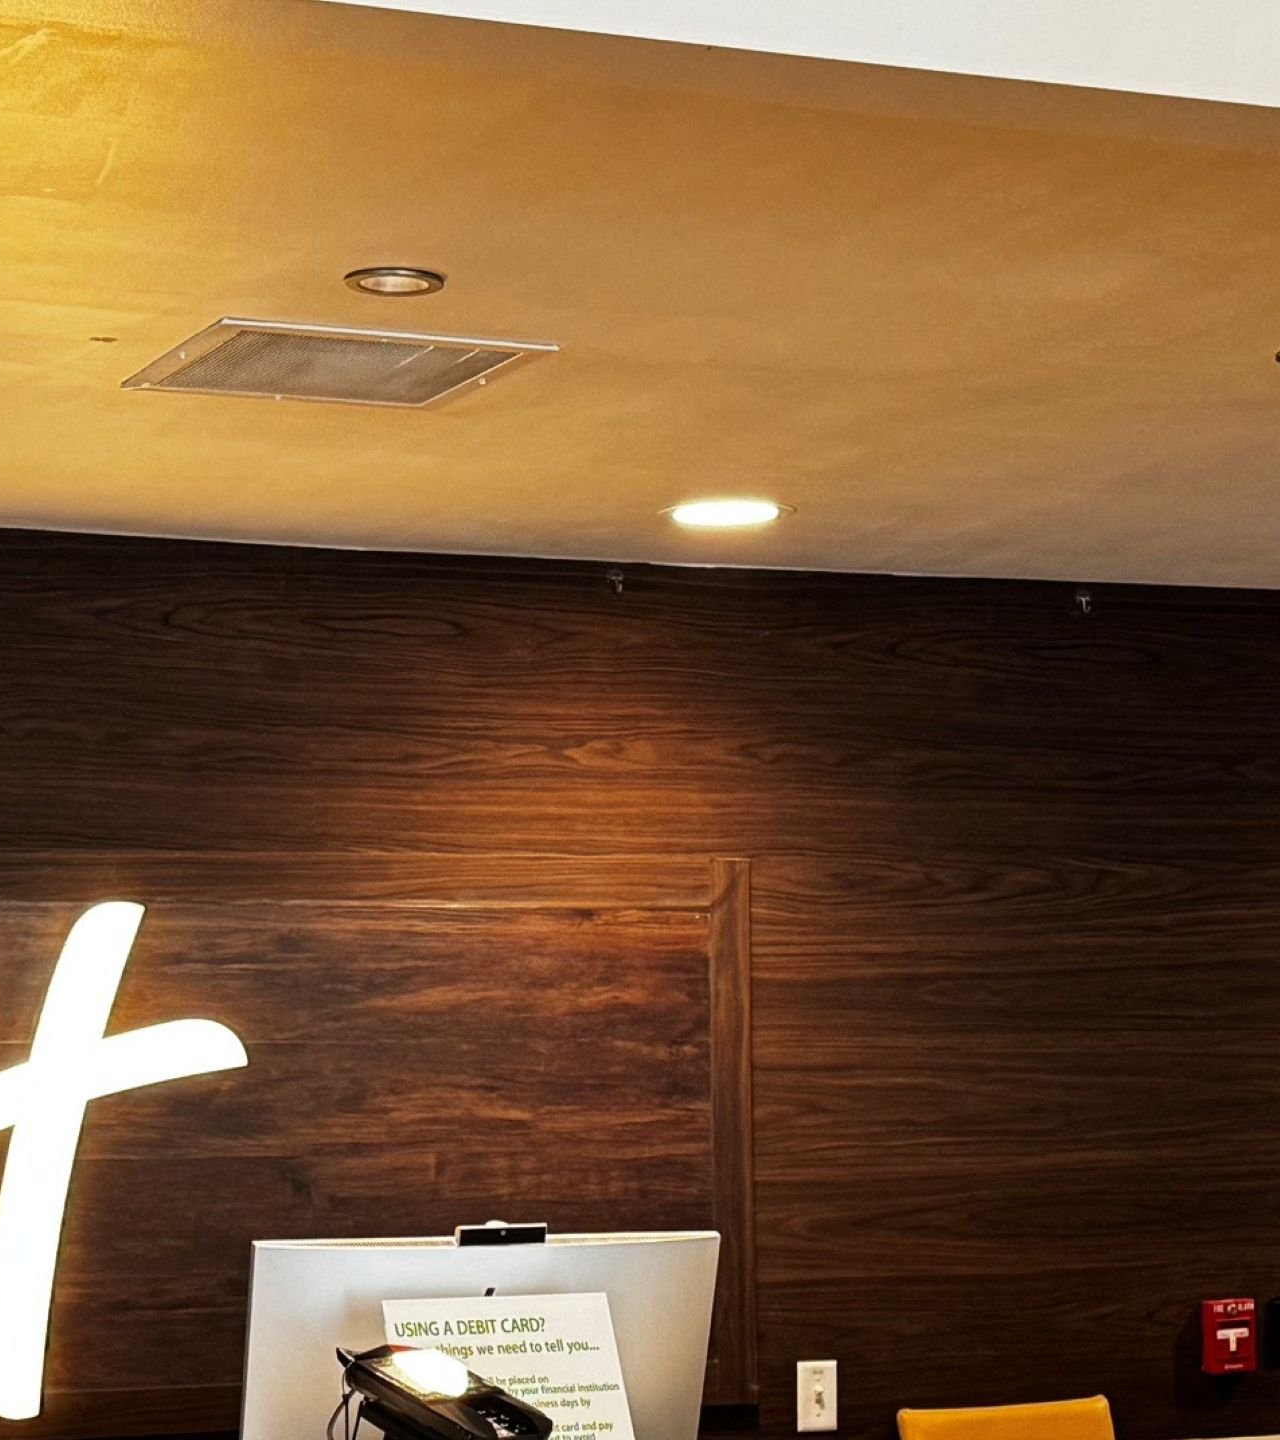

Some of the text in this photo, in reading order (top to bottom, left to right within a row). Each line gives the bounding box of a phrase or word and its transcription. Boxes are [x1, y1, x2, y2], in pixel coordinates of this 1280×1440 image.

[394, 1317, 545, 1337] USING A DEBIT CARD?
[476, 1345, 494, 1355] we
[497, 1341, 527, 1354] need
[529, 1342, 542, 1353] to
[545, 1339, 564, 1352] tell
[566, 1341, 599, 1355] you...
[509, 1375, 536, 1386] placed
[520, 1387, 539, 1397] your
[541, 1384, 576, 1394] financial
[578, 1383, 619, 1393] institution
[560, 1398, 579, 1409] days
[581, 1397, 591, 1409] by
[561, 1422, 580, 1432] card
[581, 1421, 596, 1430] and
[598, 1422, 613, 1432] pay
